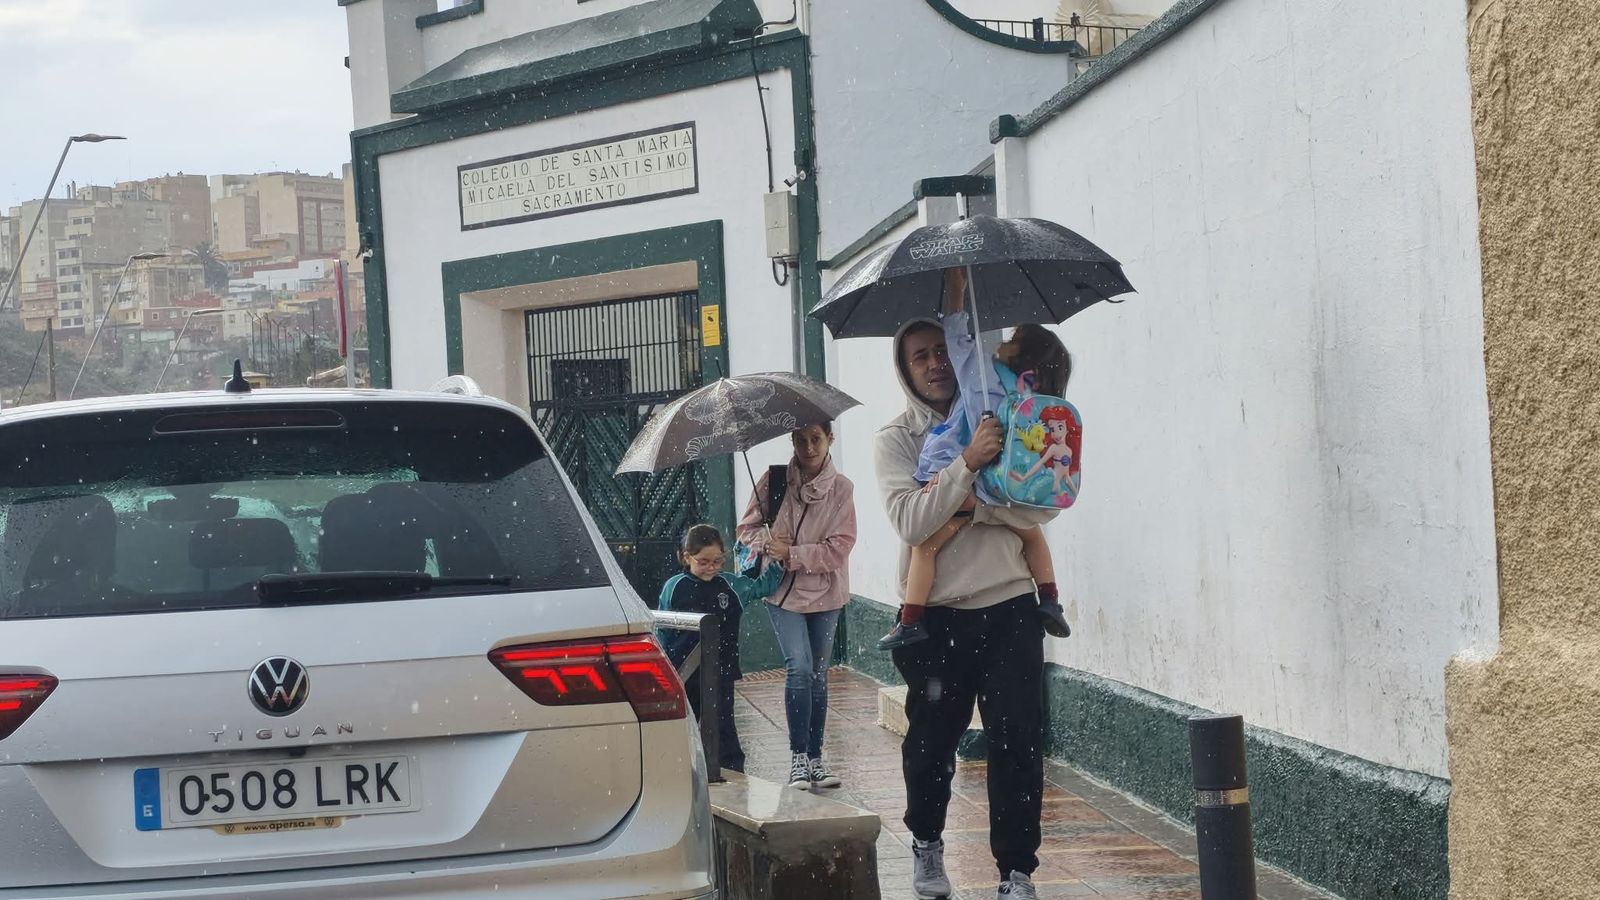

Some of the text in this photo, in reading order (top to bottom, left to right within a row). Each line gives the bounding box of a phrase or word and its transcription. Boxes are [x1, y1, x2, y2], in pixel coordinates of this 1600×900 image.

[462, 130, 693, 186] COLEGIO DE SANTA MARIA
[468, 152, 687, 204] MICAELA DEL SANTISIMO
[523, 182, 626, 213] SACRAMENTO
[208, 721, 354, 743] TIGUAN
[179, 762, 402, 816] 0508 LRK
[143, 804, 154, 817] E
